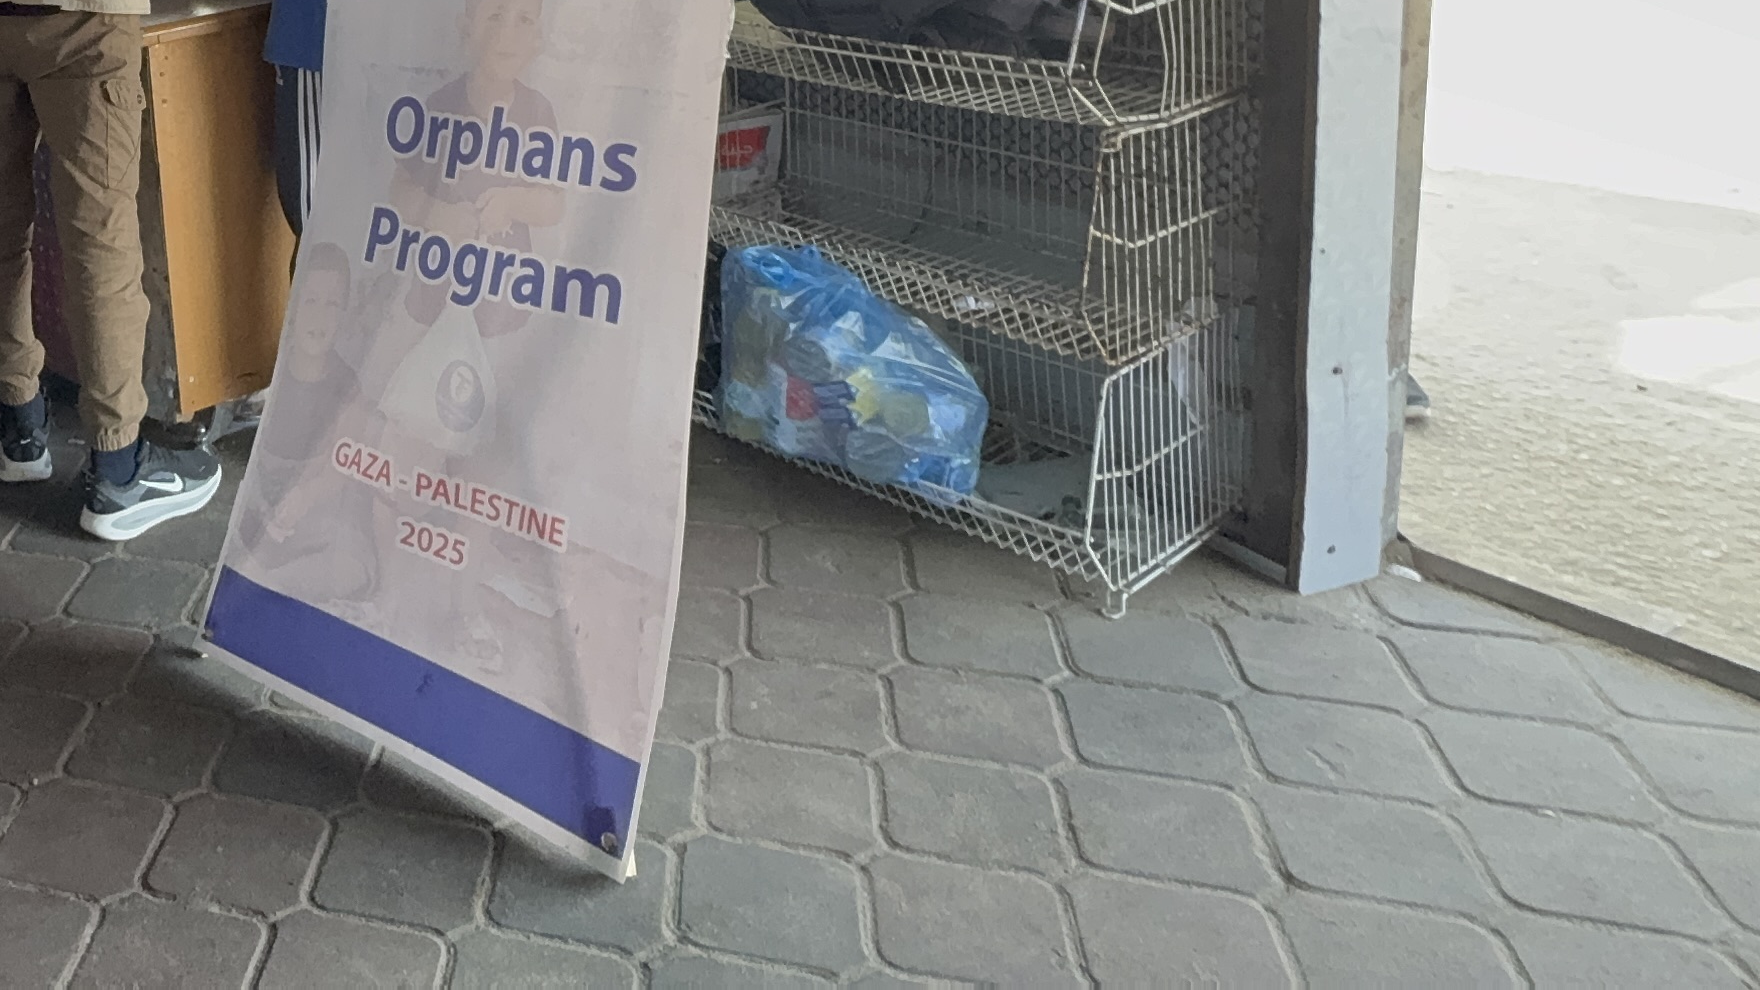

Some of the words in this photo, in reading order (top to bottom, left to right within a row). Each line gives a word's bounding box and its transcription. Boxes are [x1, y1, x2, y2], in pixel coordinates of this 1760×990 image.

[386, 95, 638, 193] Orphans
[364, 206, 622, 325] Program
[335, 441, 391, 487] GAZA
[415, 471, 566, 548] PALESTINE
[399, 520, 466, 566] 2025
